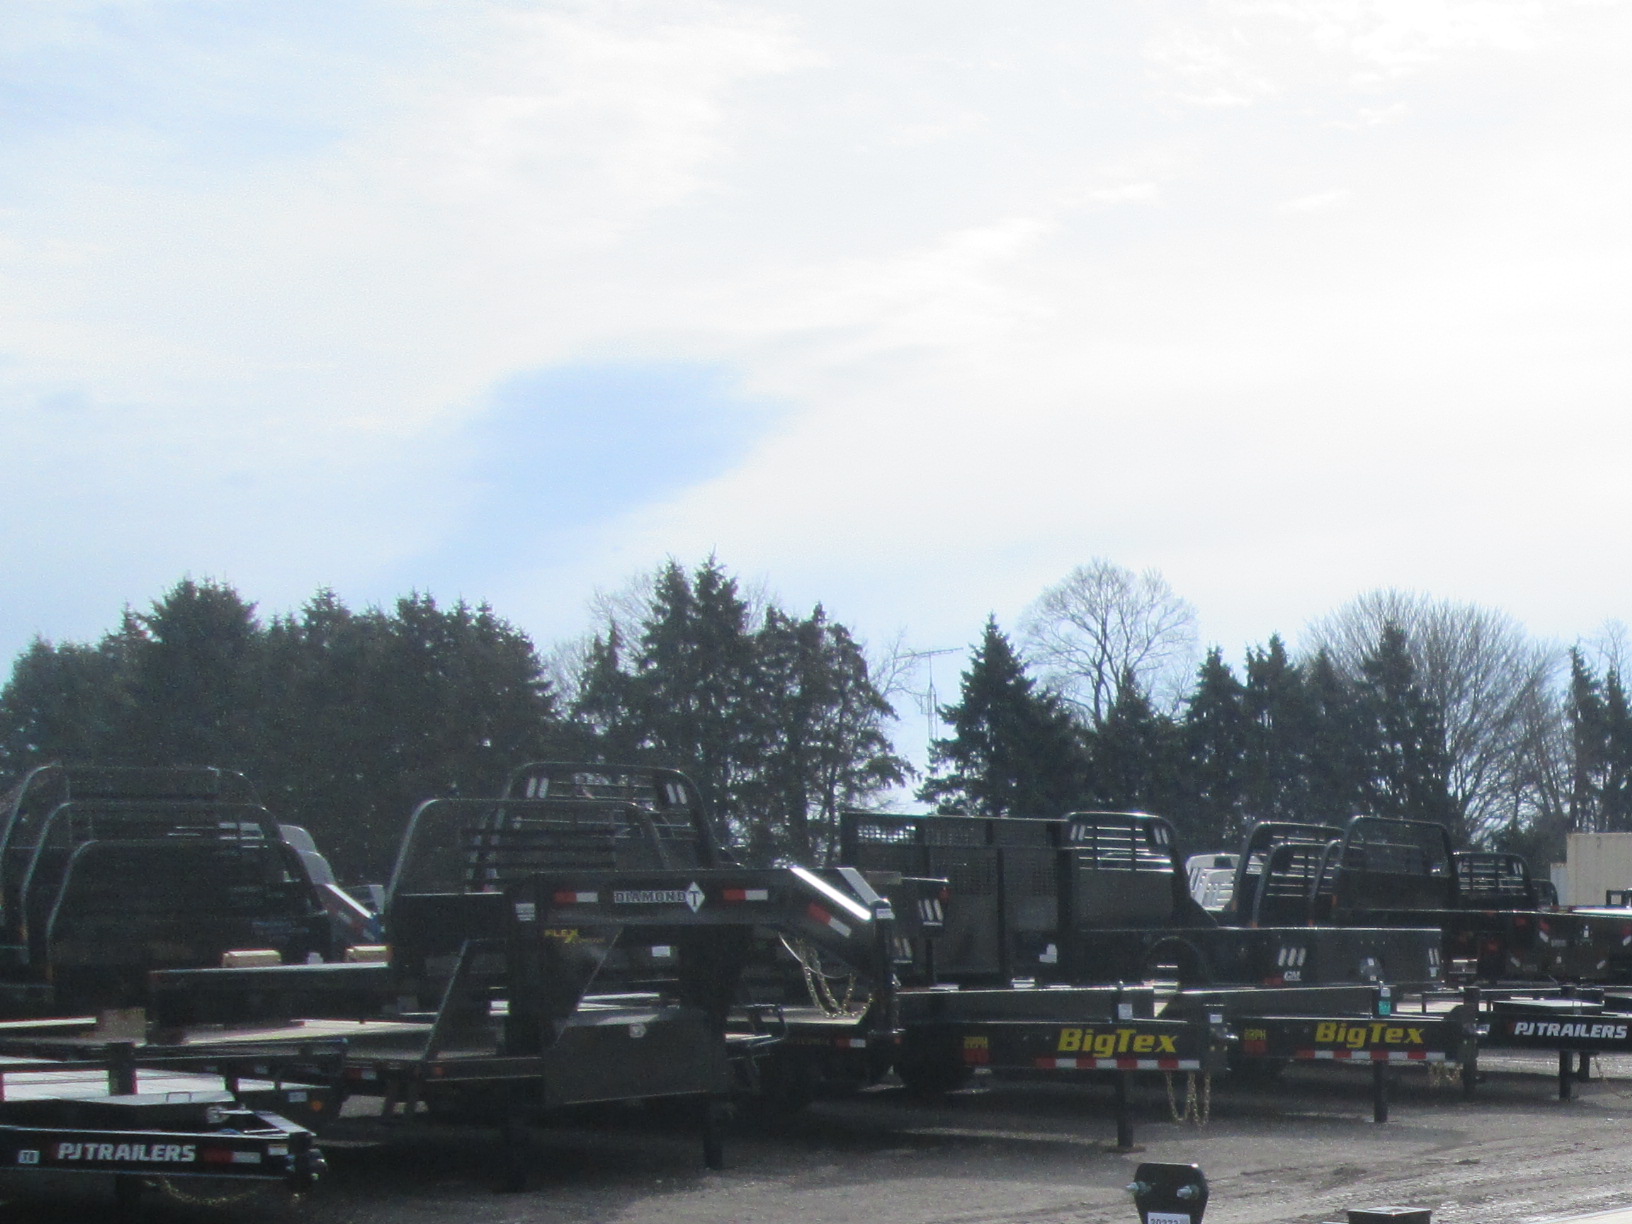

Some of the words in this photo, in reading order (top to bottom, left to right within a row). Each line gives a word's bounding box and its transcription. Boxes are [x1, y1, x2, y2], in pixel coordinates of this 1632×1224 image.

[614, 890, 687, 904] DIAMOND
[1314, 1021, 1425, 1048] BigTex
[1536, 1022, 1628, 1039] TRAILERS
[1057, 1028, 1179, 1058] BigTex
[84, 1143, 196, 1162] TRAILERS
